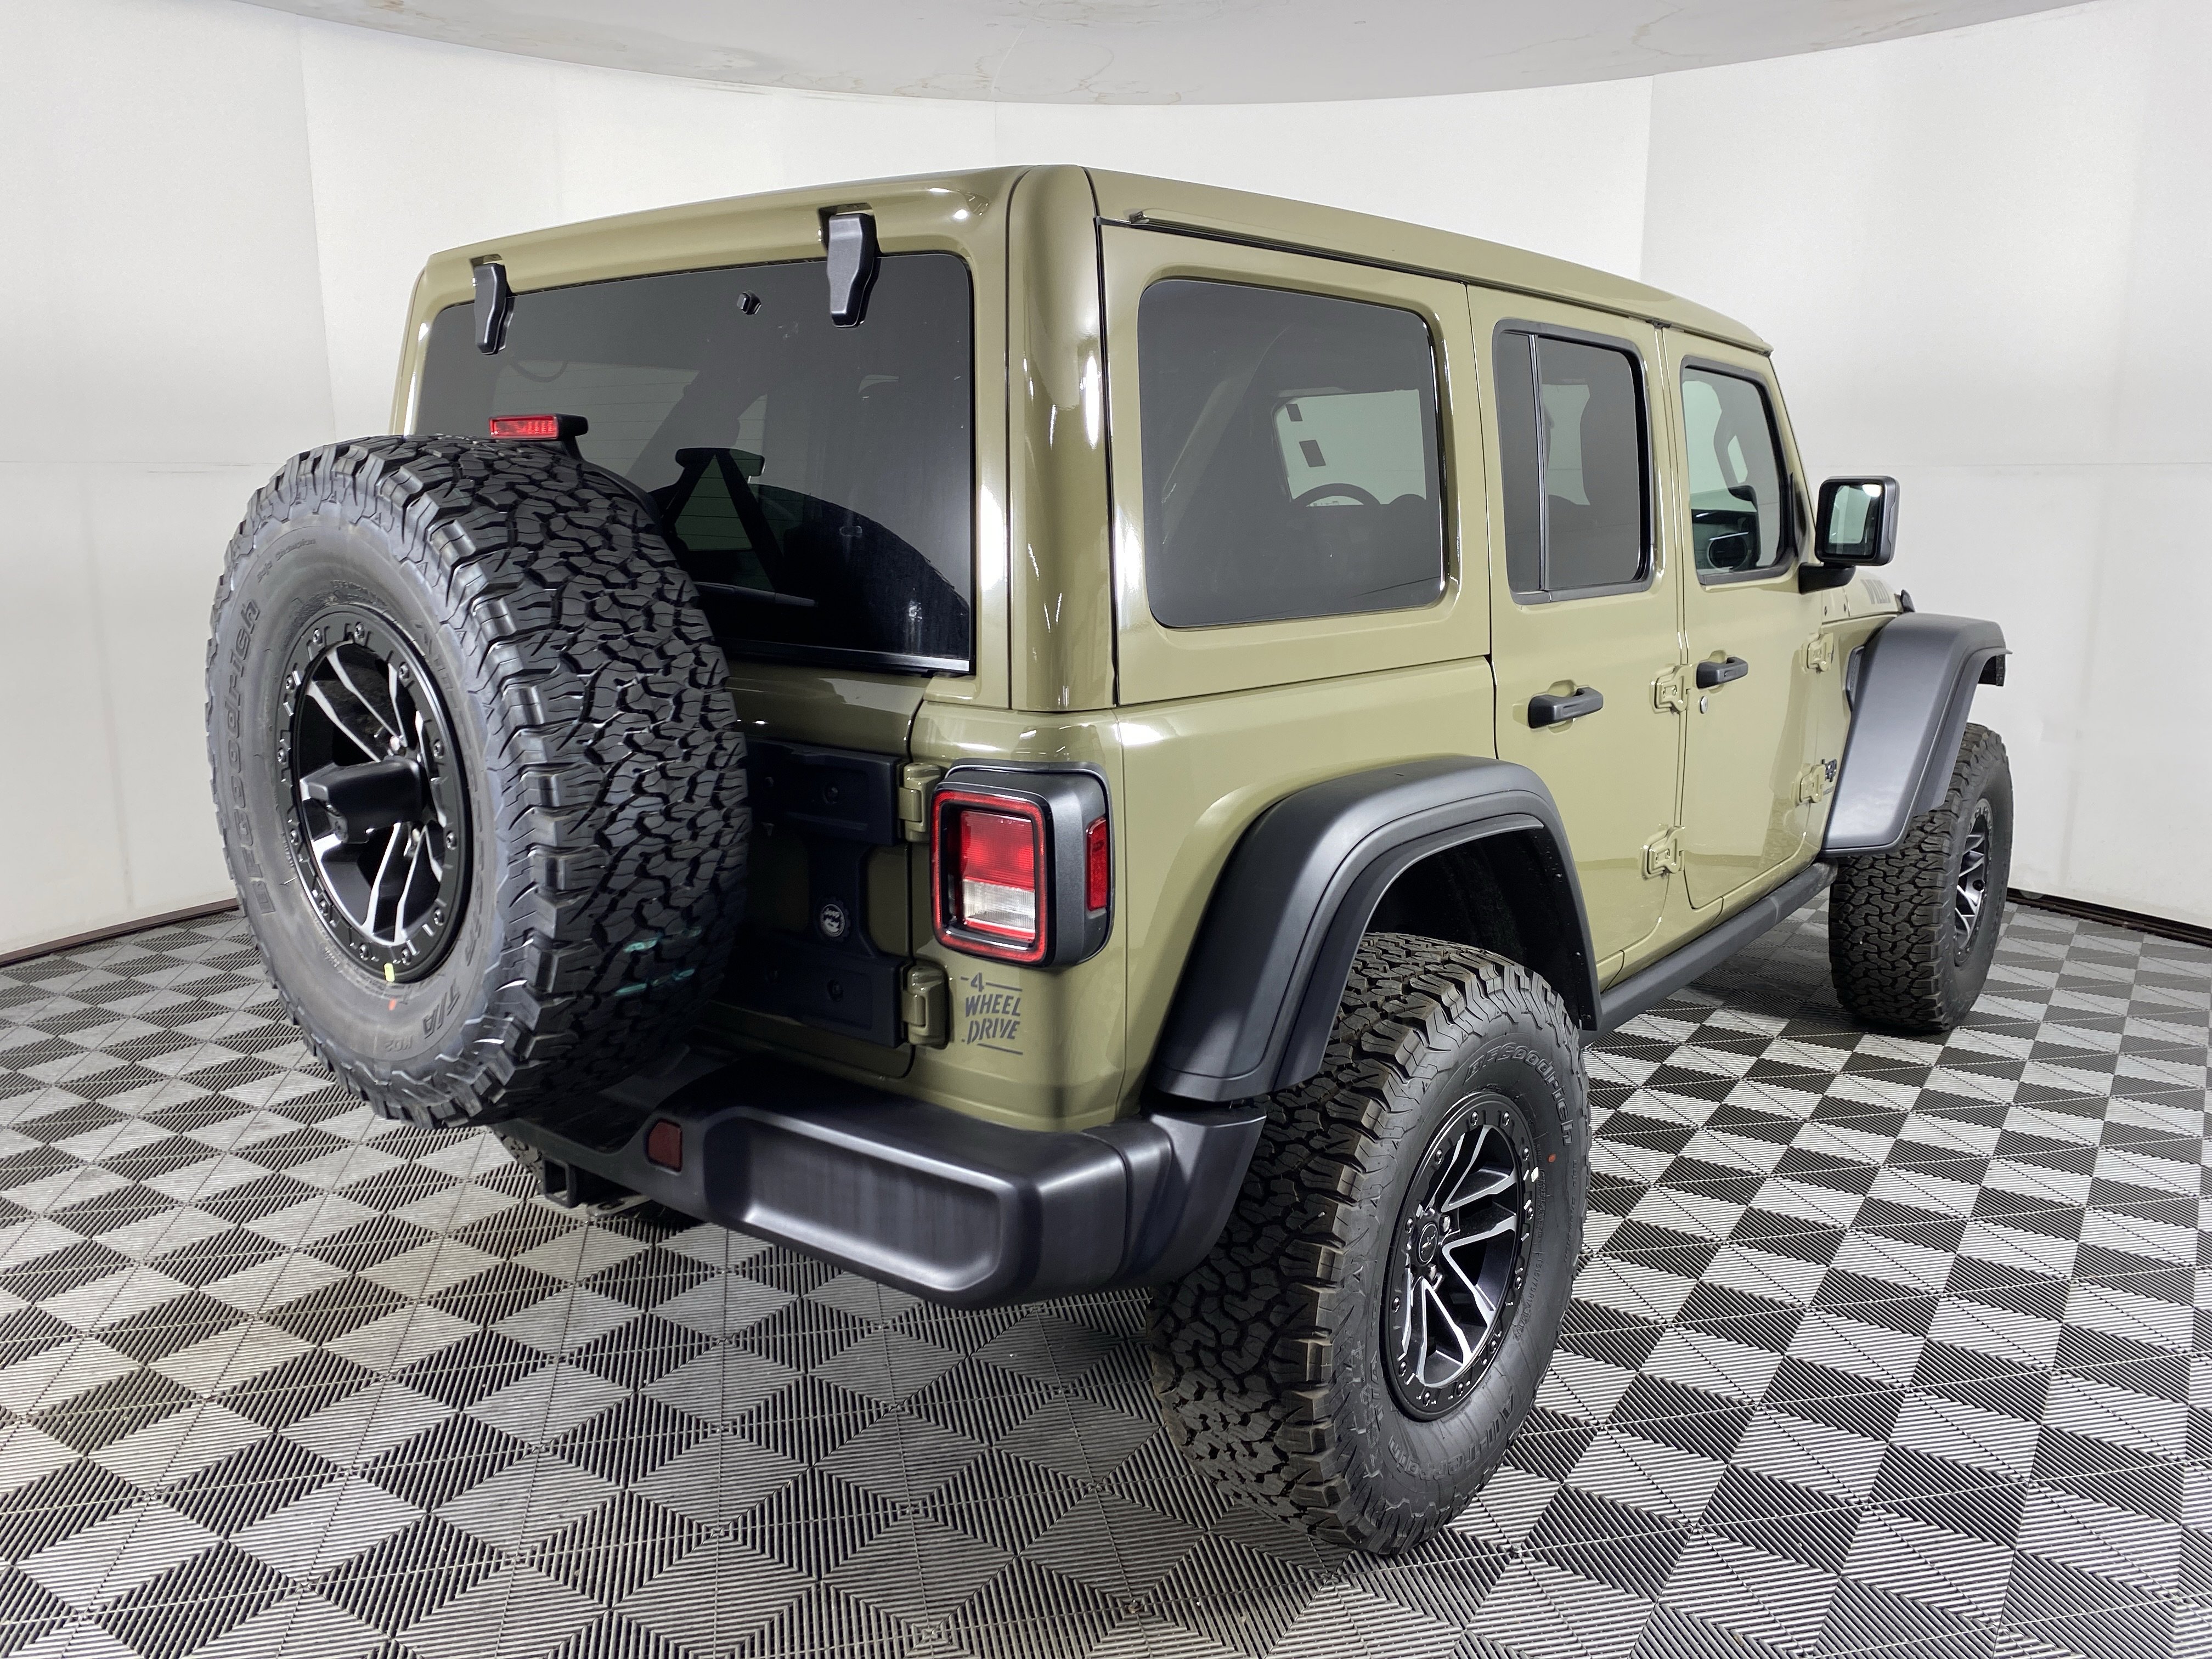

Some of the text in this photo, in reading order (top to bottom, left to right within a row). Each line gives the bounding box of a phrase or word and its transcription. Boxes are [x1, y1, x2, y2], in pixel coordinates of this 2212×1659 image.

[970, 972, 984, 992] 4
[966, 994, 1021, 1018] WHEEL
[967, 1018, 1020, 1045] DRIVE
[1463, 1042, 1573, 1147] BFGoodrich
